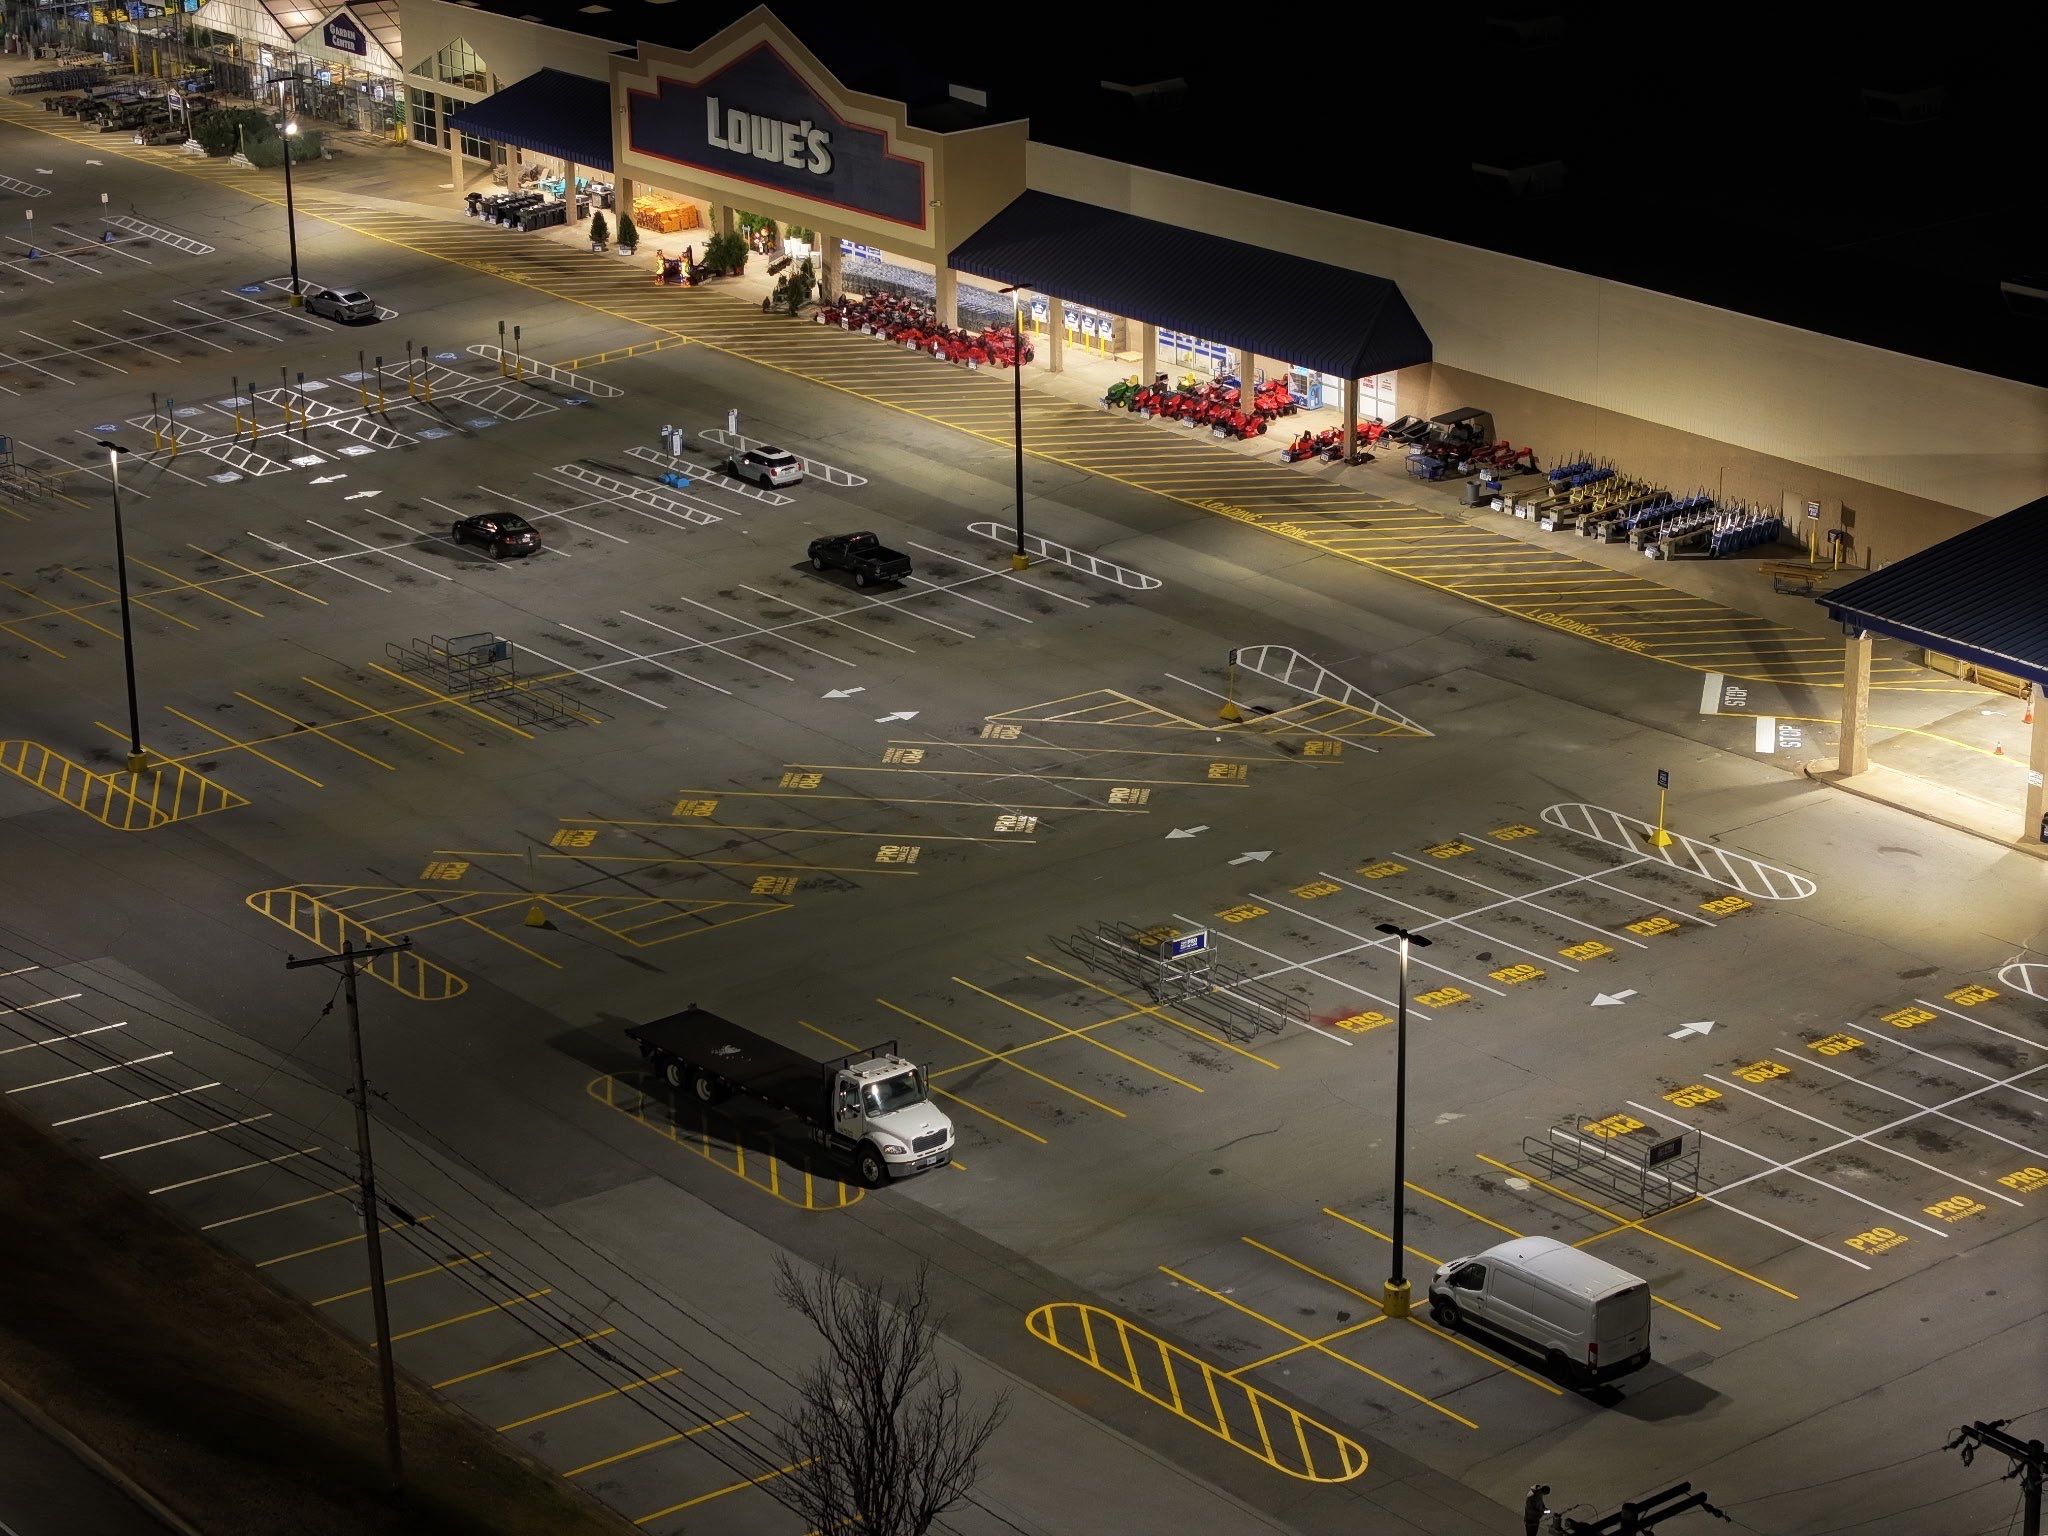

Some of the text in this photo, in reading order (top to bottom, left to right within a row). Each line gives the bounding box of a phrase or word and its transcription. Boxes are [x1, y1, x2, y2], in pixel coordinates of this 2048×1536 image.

[329, 23, 356, 40] GARDEN
[332, 35, 355, 51] CENTER
[706, 96, 832, 174] LOWE'S
[1199, 500, 1316, 539] LOADING ZONE
[1526, 608, 1646, 651] LOADING ZONE
[1725, 686, 1747, 707] STOP
[1000, 725, 1022, 739] PRO
[1779, 725, 1802, 748] STOP
[902, 749, 925, 763] PRO
[1304, 741, 1324, 755] PRO
[1208, 763, 1228, 778] PRO
[799, 774, 823, 788] PRO
[1108, 788, 1130, 803] PRO
[693, 800, 718, 816] PRO
[994, 815, 1017, 831] PRO
[1014, 816, 1028, 832] TRAILER
[1025, 816, 1038, 833] PARKING
[571, 830, 598, 847] PRO
[1495, 825, 1537, 840] PRO
[875, 845, 900, 862] PRO
[896, 846, 910, 863] TRAILER
[907, 847, 920, 863] PARKING
[1431, 844, 1475, 858] PRO
[441, 862, 470, 880] PRO
[1364, 862, 1408, 879] PRO
[751, 876, 776, 894] PRO
[1297, 884, 1342, 899] PRO
[1699, 896, 1742, 912] PRO
[1715, 902, 1752, 915] PARKING
[1223, 906, 1269, 922] PRO
[1626, 917, 1670, 934] PRO
[1642, 923, 1680, 937] PARKING
[1558, 941, 1603, 958] PRO
[1574, 948, 1613, 961] PARKING
[1488, 965, 1535, 982] PRO
[1504, 970, 1544, 984] PARKING
[1414, 988, 1462, 1004] PRO
[1944, 985, 1982, 999] PARKING
[1955, 988, 1999, 1006] PRO
[1430, 993, 1470, 1008] PARKING
[1335, 1012, 1383, 1030] PRO
[1880, 1007, 1918, 1021] PARKING
[1891, 1010, 1937, 1027] PRO
[1351, 1017, 1393, 1033] PARKING
[1807, 1033, 1846, 1048] PARKING
[1818, 1036, 1864, 1055] PRO
[1732, 1060, 1771, 1075] PARKING
[1743, 1063, 1790, 1082] PRO
[1663, 1085, 1705, 1100] PARKING
[1673, 1087, 1722, 1107] PRO
[1594, 1117, 1645, 1137] PRO
[1996, 1167, 2047, 1189] PRO
[1923, 1196, 1973, 1219] PRO
[1944, 1203, 1986, 1223] PARKING
[1845, 1227, 1896, 1250] PRO
[1865, 1235, 1908, 1255] PARKING
